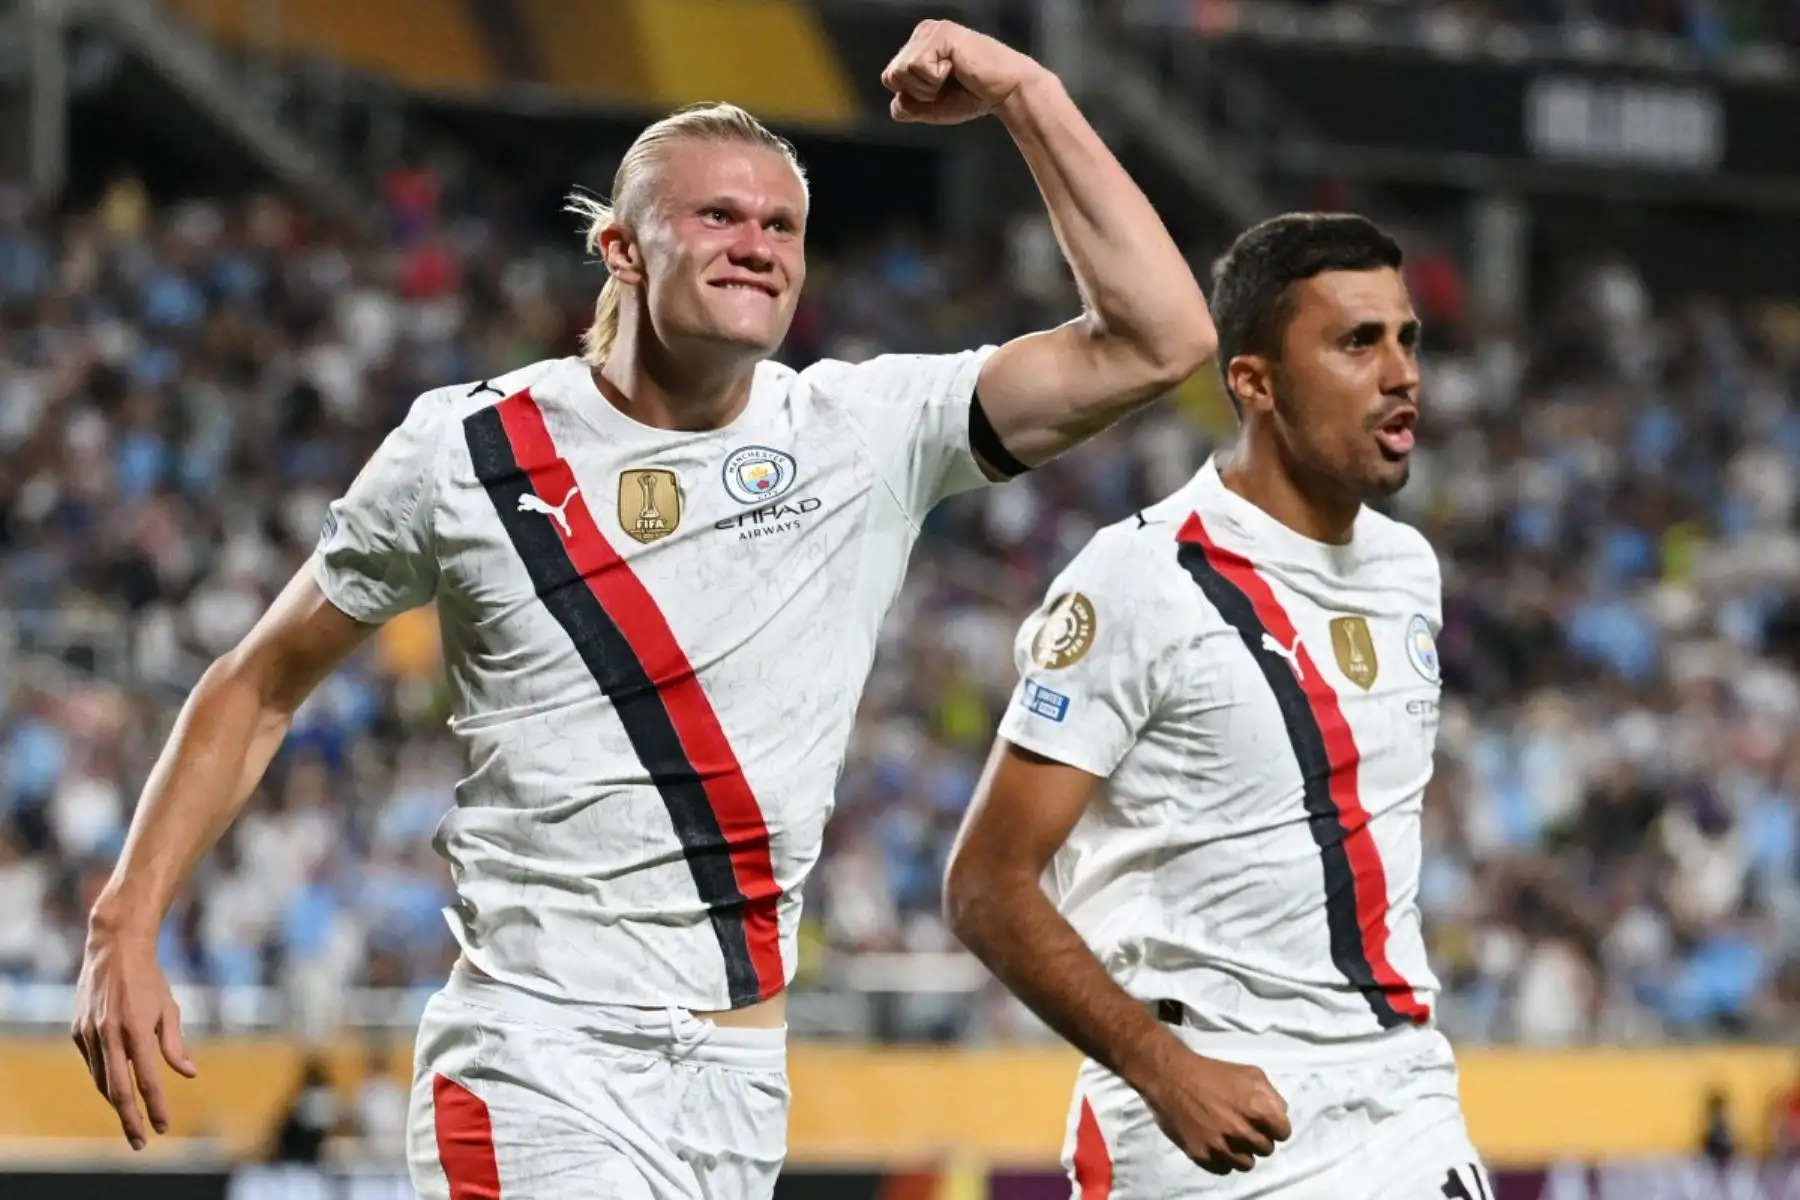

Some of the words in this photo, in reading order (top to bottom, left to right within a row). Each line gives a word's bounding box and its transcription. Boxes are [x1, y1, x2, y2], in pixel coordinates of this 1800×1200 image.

[729, 450, 786, 473] MANCHESTER
[636, 519, 665, 529] FIFA
[714, 497, 822, 530] ETIHAD
[739, 519, 801, 541] AIRWAYS
